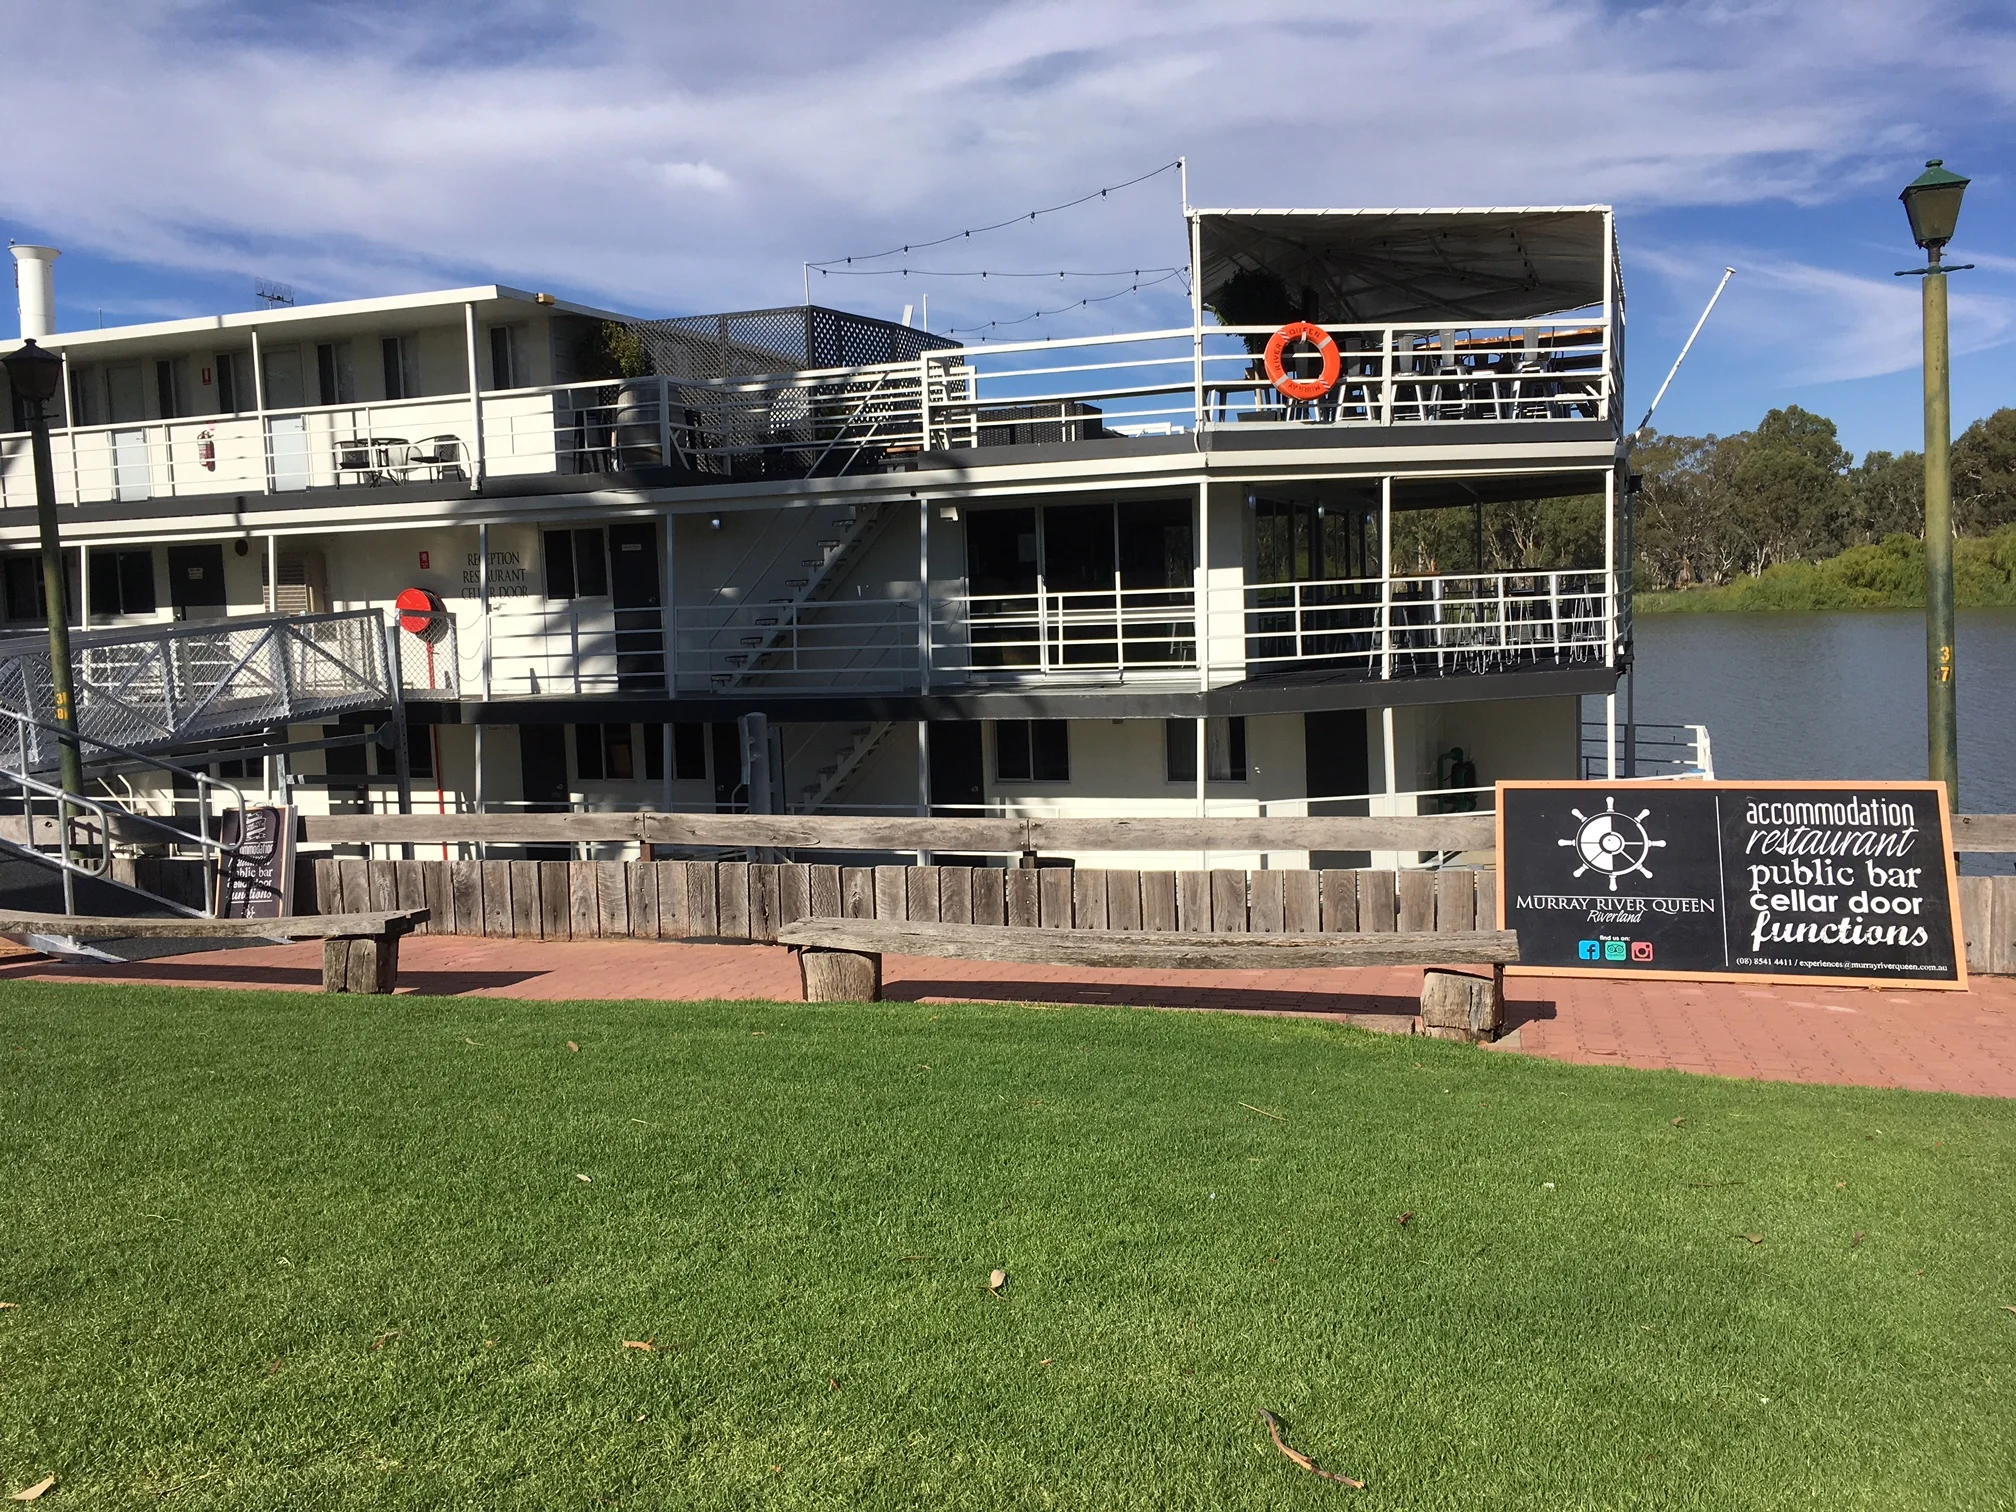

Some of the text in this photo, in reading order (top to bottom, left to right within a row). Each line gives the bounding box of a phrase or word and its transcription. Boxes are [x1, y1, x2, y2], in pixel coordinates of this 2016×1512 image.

[1273, 343, 1282, 371] RIVER
[1289, 327, 1321, 338] QUEEN
[499, 585, 528, 598] DOOR
[1746, 795, 1915, 827] accommodation
[1745, 825, 1919, 857] restaurant
[1746, 857, 1922, 891] public bar
[1516, 895, 1715, 914] MURRAY RIVER QUEEN
[1586, 909, 1644, 923] Riverland
[1749, 888, 1924, 915] cellar door
[1750, 910, 1929, 952] functions
[1736, 957, 1753, 966] (08)
[1753, 957, 1772, 966] 8541
[1773, 958, 1793, 966] 4411
[1799, 959, 1948, 972] experiences@murrayriverqueen.com.au
